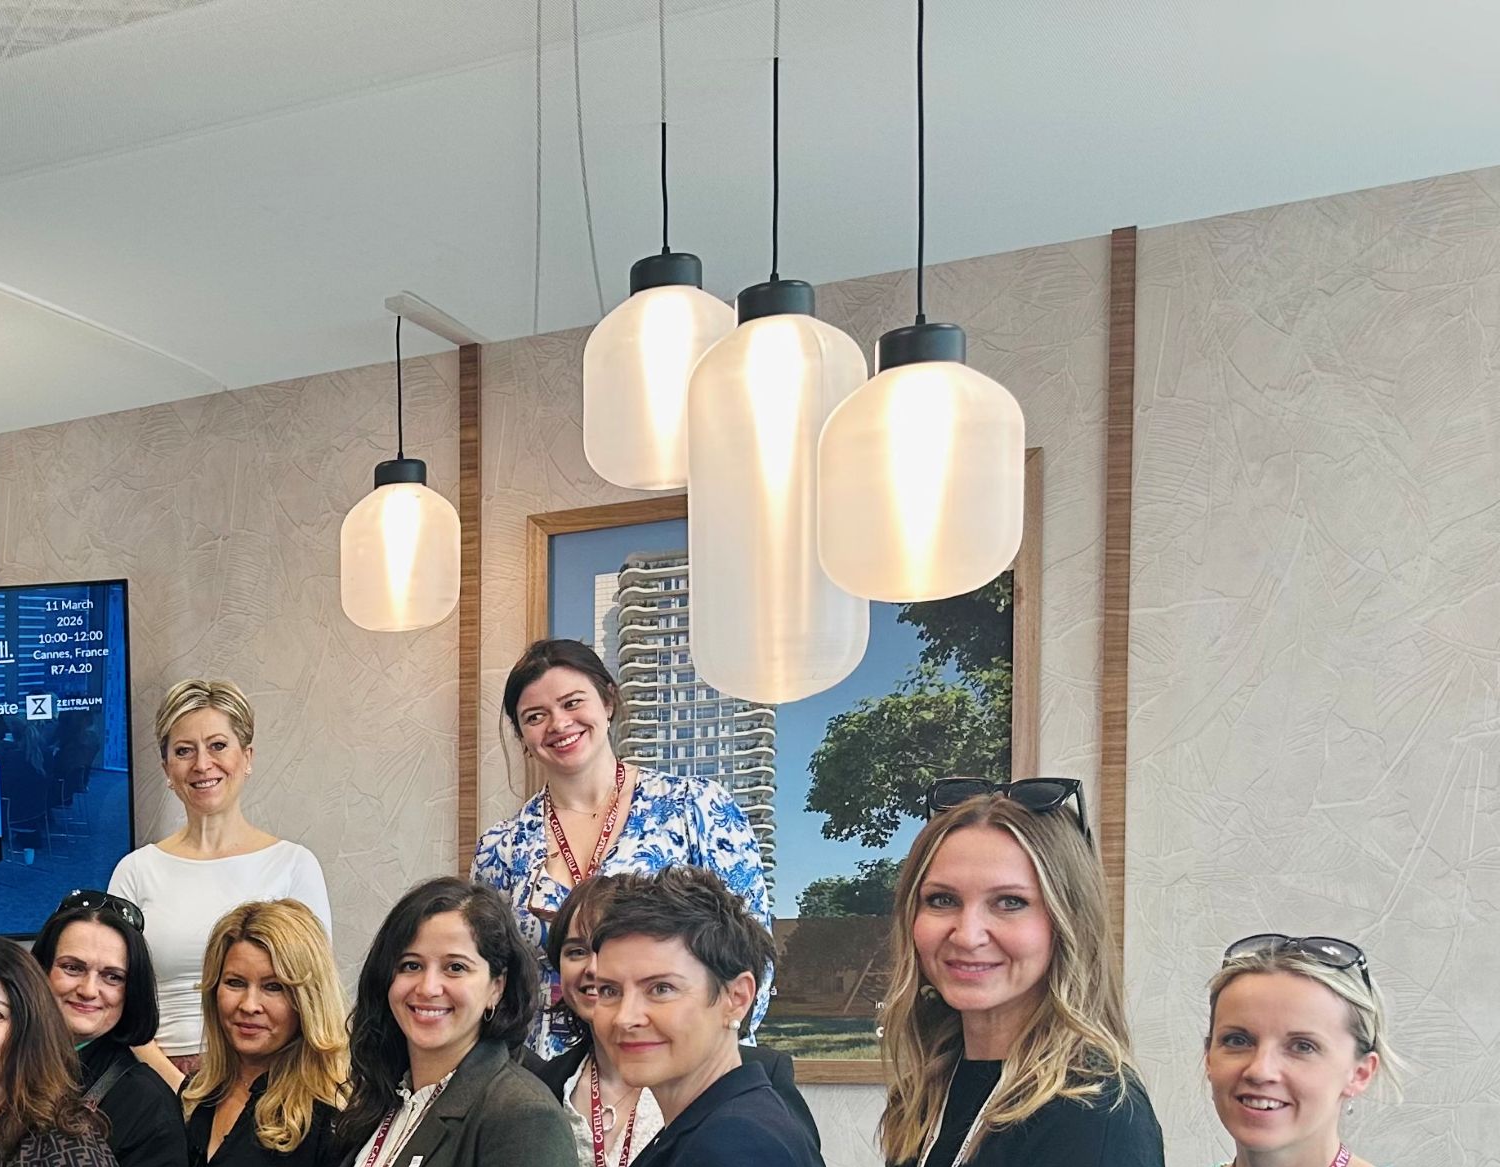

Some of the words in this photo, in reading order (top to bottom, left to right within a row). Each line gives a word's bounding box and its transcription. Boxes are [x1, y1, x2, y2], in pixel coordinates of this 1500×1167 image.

[45, 601, 58, 612] 11
[61, 599, 94, 611] March
[56, 615, 84, 627] 2026
[33, 648, 73, 661] Cannes,
[75, 646, 109, 658] France
[51, 662, 93, 676] R7-A.20
[56, 697, 103, 707] ZEITRAUM
[551, 818, 565, 846] CATELLA
[562, 847, 577, 873] CATELLA
[593, 1105, 604, 1144] CATELLA
